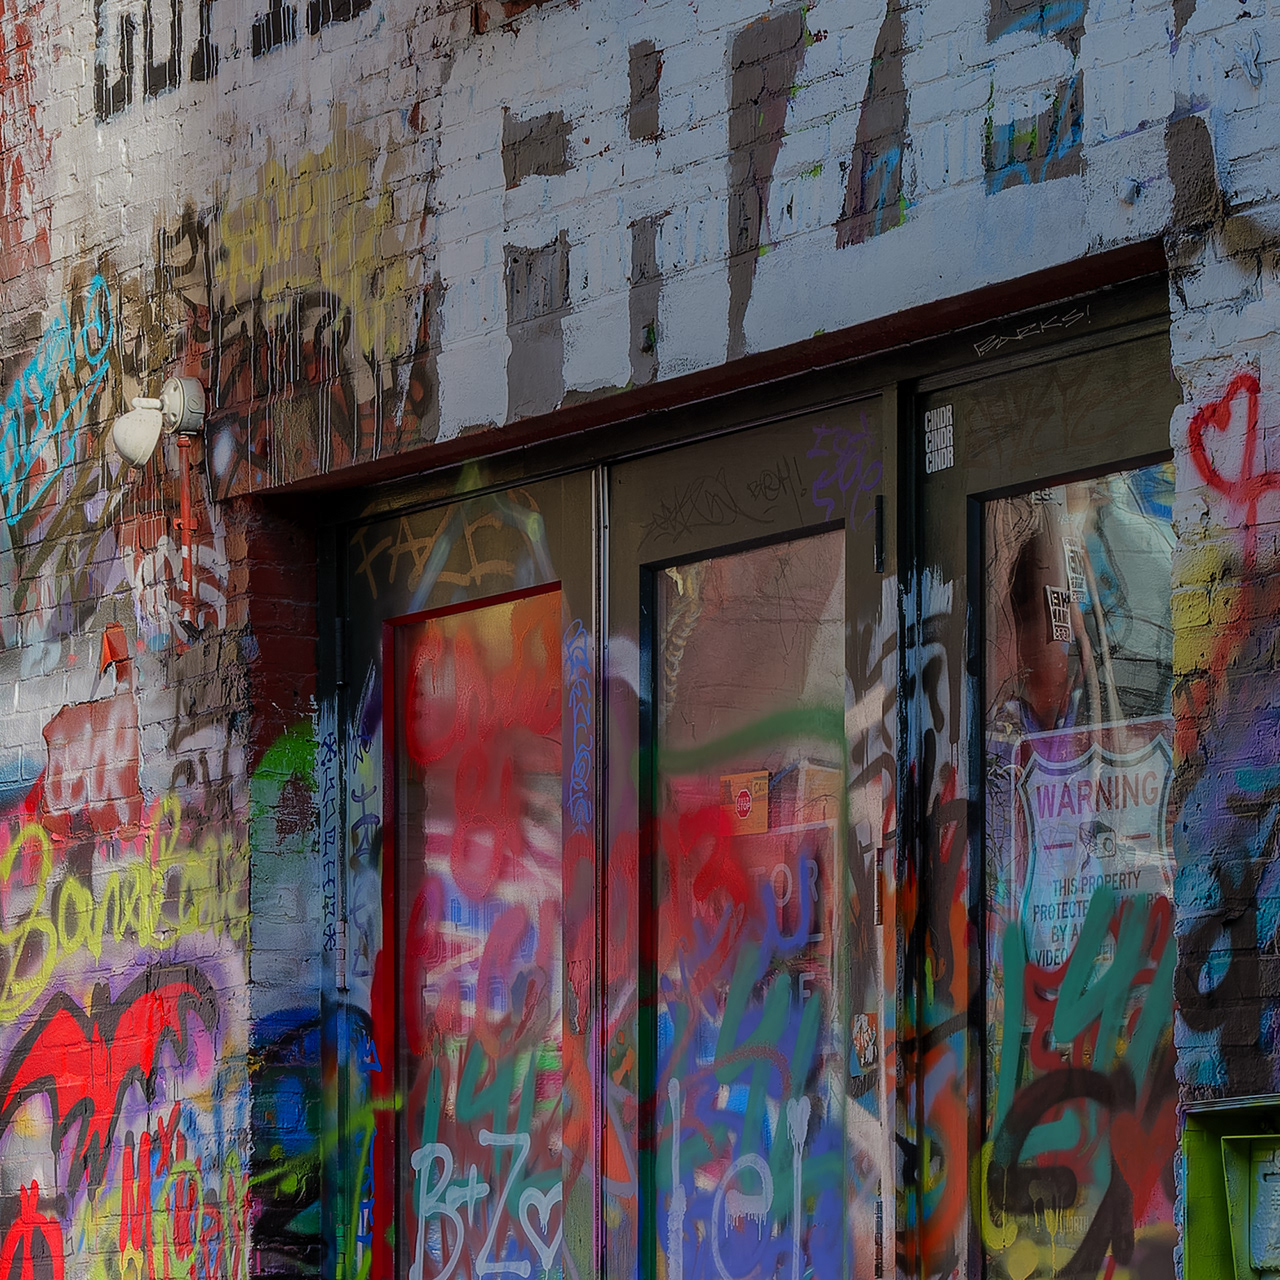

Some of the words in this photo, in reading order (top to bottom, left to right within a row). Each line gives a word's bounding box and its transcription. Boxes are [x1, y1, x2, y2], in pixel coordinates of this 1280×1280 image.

[924, 404, 953, 432] CINDR
[925, 425, 953, 453] CINDR
[925, 446, 954, 475] CINDR
[1036, 770, 1159, 819] WARNING
[1052, 876, 1078, 897] THIS
[1081, 870, 1142, 895] PROPERTY
[1032, 898, 1090, 924] PROTECTE
[1051, 925, 1068, 944] BY
